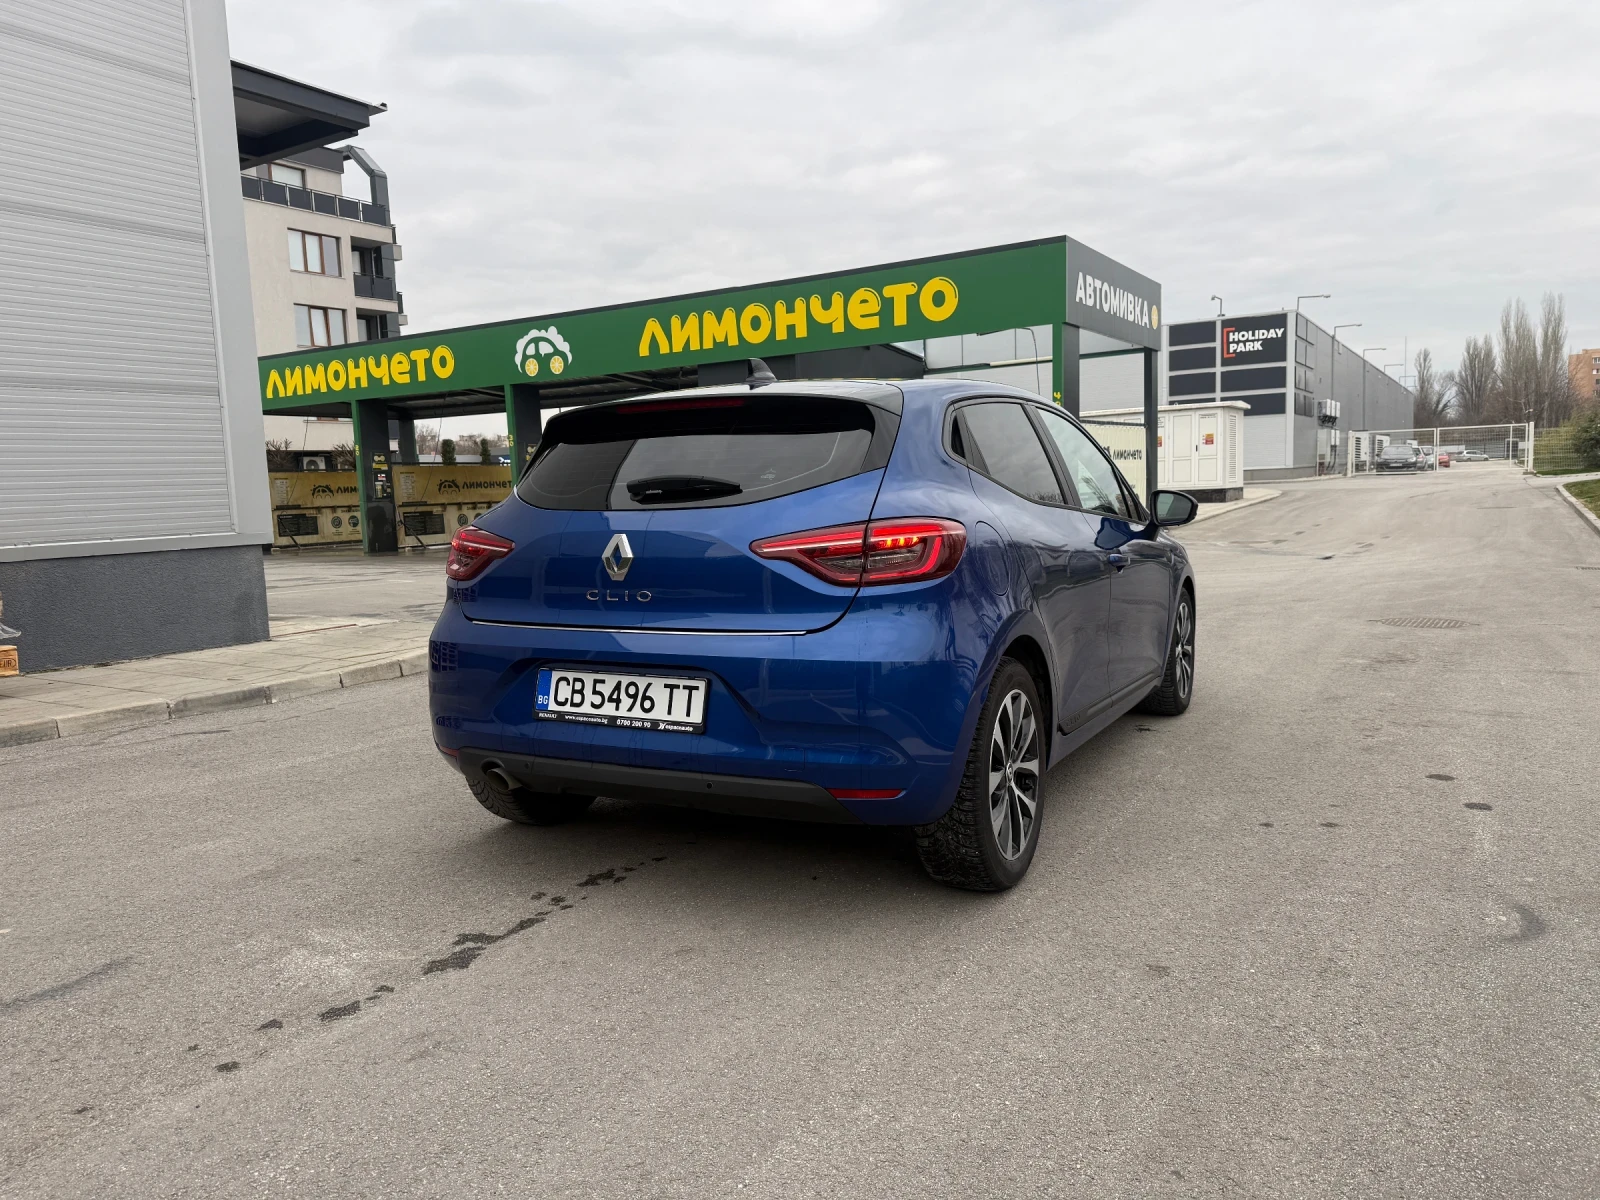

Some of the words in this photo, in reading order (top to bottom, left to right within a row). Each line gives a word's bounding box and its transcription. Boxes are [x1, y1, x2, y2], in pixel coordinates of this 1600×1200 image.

[1075, 272, 1150, 328] АВТОМИВКА
[1229, 328, 1285, 342] HOLIDAY
[1229, 340, 1263, 353] PARK
[462, 480, 512, 489] ЛИМОНЧеТ
[585, 589, 652, 602] CLIO
[537, 694, 549, 704] BG
[553, 676, 585, 708] CB
[591, 678, 656, 714] 5496
[663, 683, 700, 718] TT
[616, 719, 631, 727] 0700
[631, 720, 643, 728] 200
